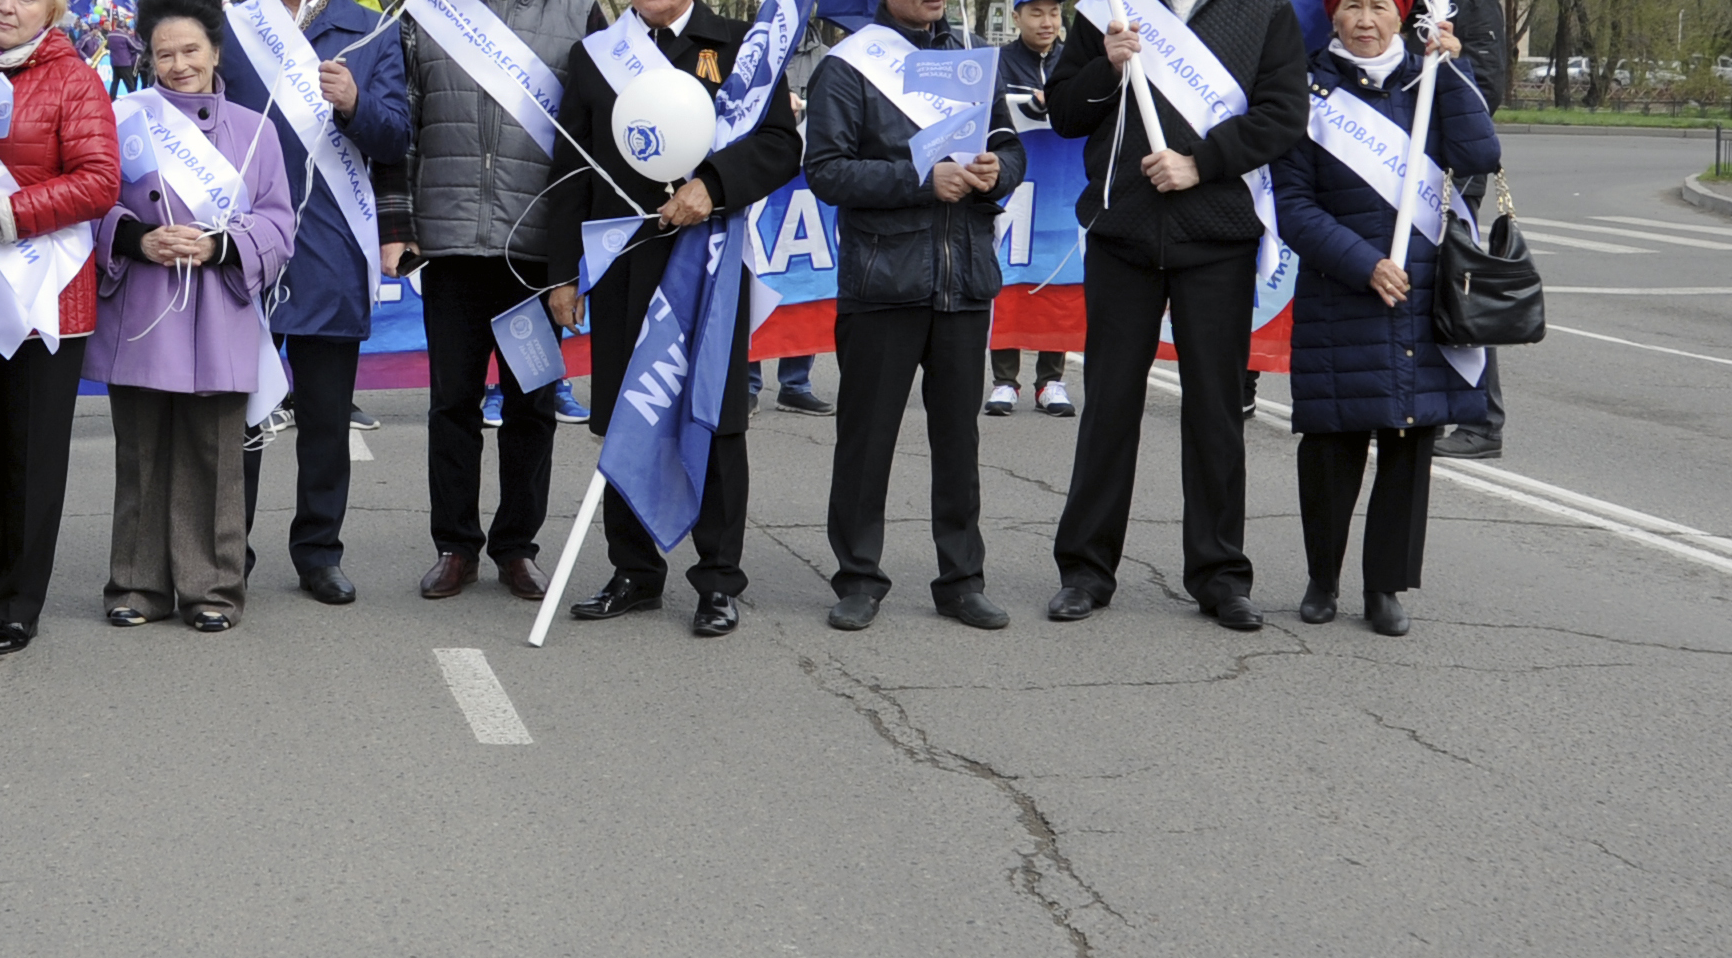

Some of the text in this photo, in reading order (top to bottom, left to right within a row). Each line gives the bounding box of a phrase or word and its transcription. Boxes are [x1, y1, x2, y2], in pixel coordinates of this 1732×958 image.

[1167, 57, 1233, 121] ДОБЛЕСТ
[150, 123, 215, 185] ТРУДОВАЯ
[337, 146, 373, 222] ХАКАСИИ
